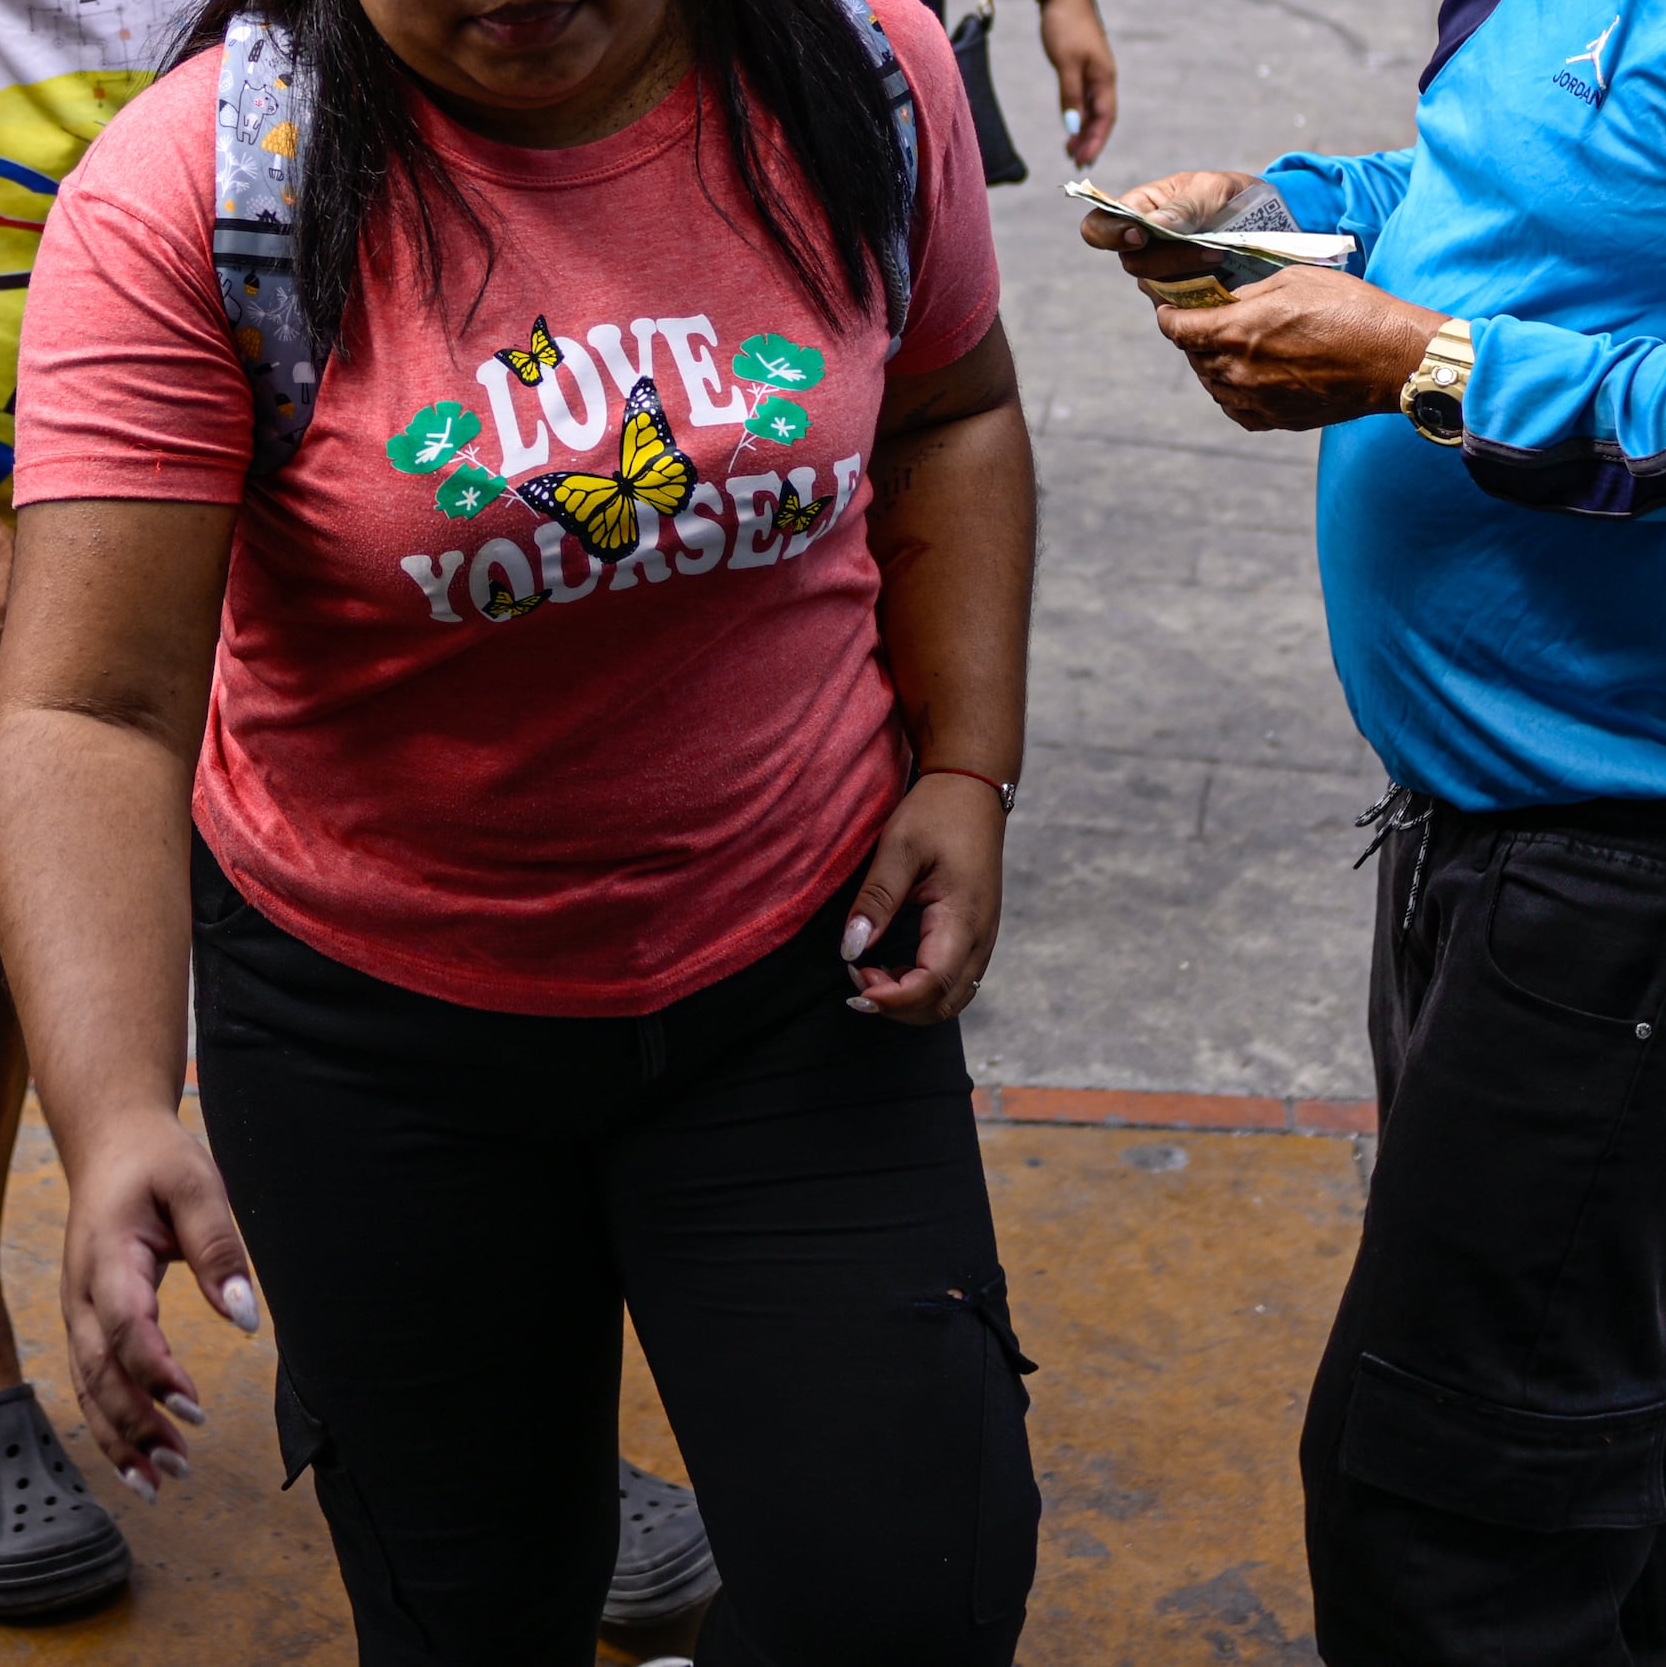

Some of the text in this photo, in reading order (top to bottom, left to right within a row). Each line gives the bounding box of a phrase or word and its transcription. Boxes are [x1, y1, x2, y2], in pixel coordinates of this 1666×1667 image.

[1552, 69, 1603, 110] JORDAN
[475, 313, 748, 479] LOVE
[399, 452, 863, 624] YOURSELF
